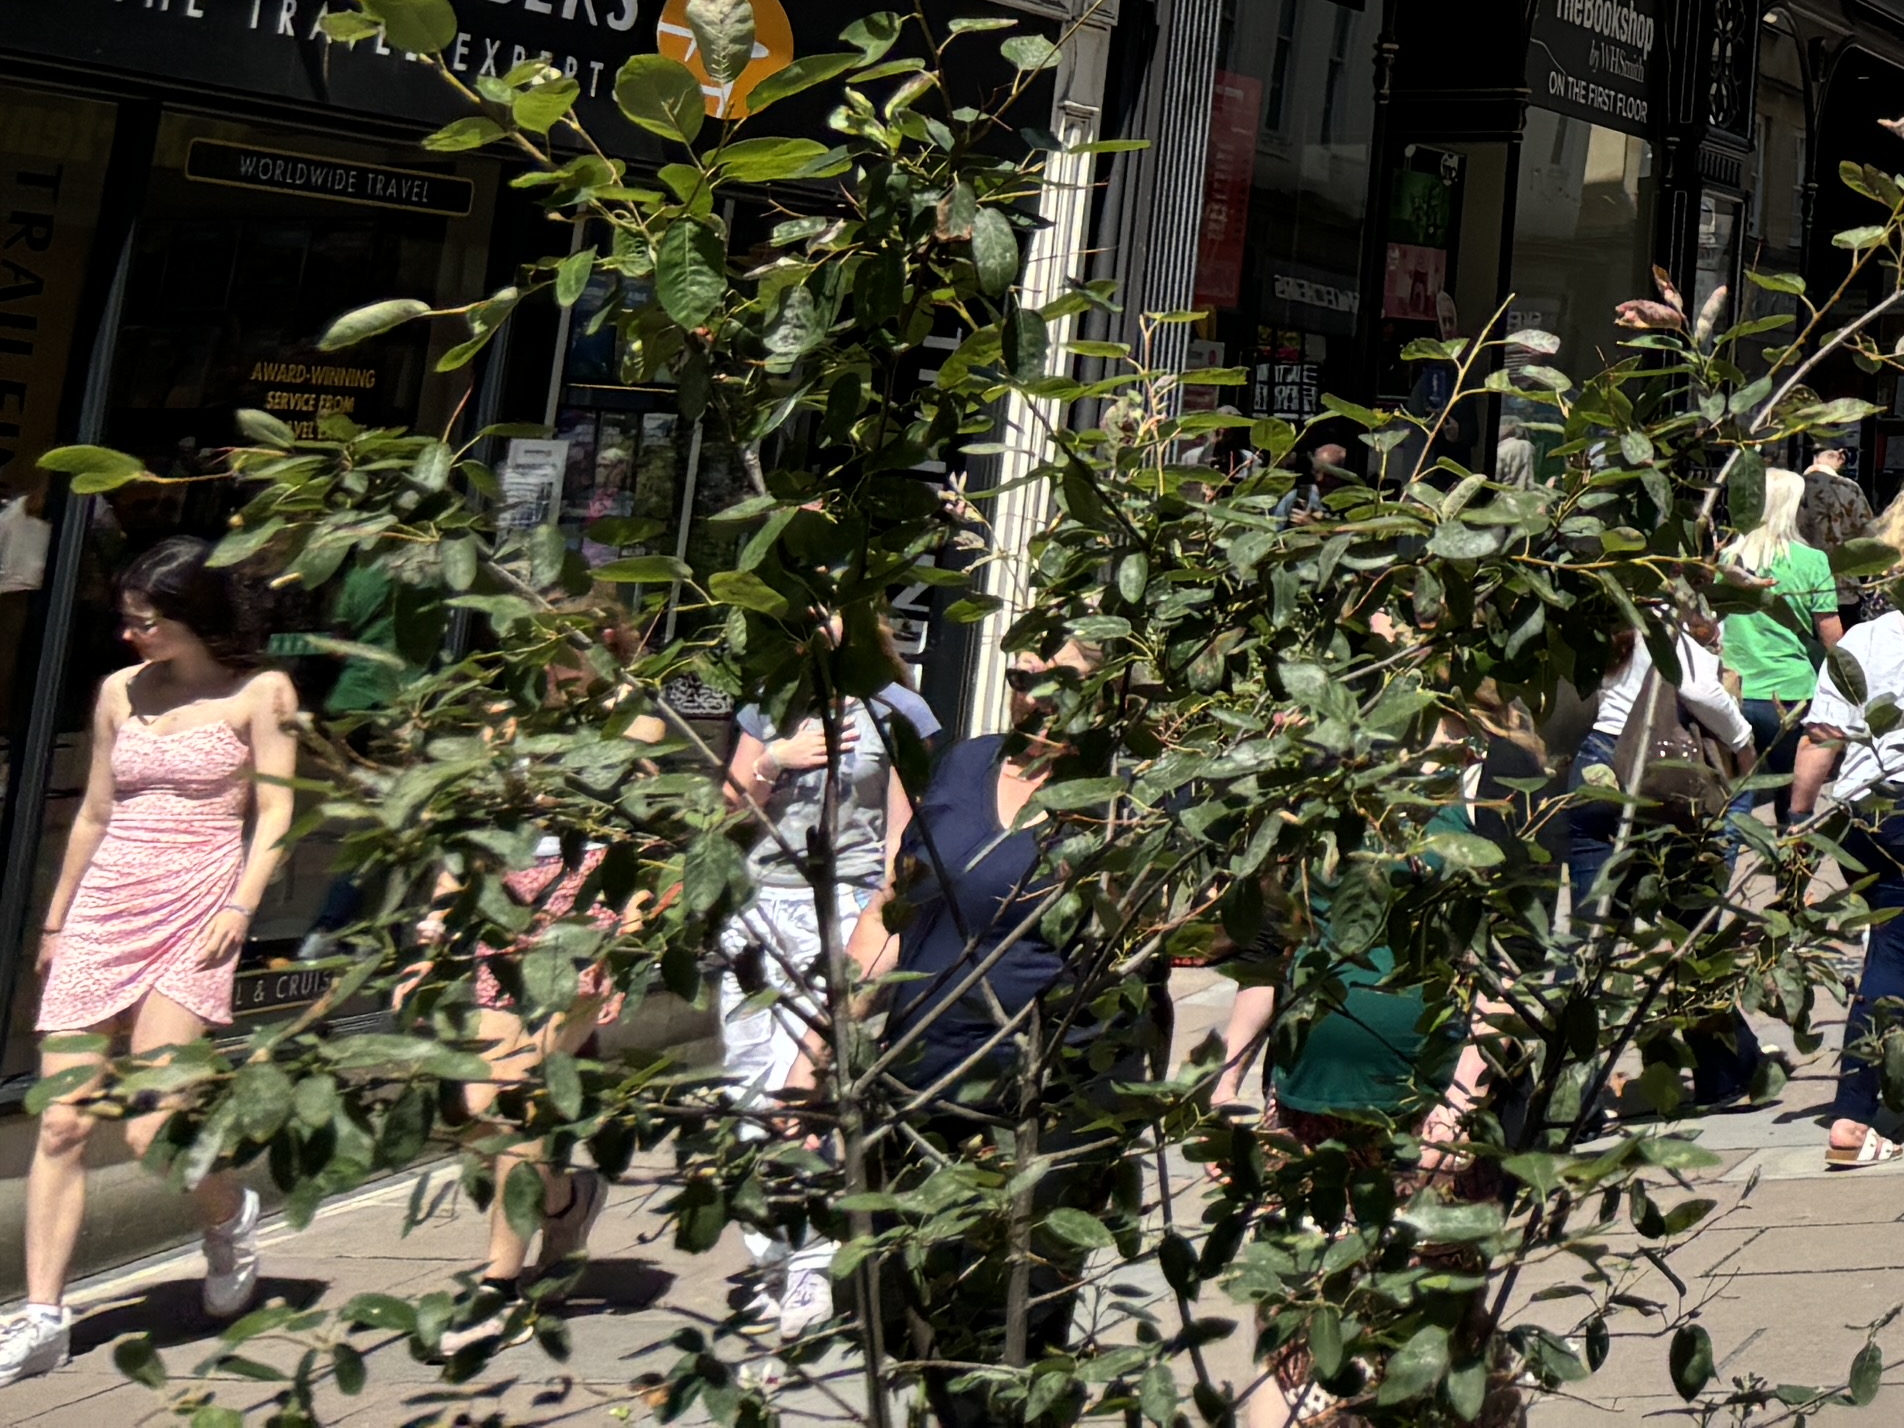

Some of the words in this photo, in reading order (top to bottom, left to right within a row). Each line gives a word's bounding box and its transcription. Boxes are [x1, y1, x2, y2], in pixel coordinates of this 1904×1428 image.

[1589, 39, 1600, 74] by
[1601, 41, 1646, 84] WHSmith
[1548, 70, 1566, 97] ON
[1566, 75, 1587, 105] THE
[1587, 82, 1615, 113] FIRST
[1615, 92, 1648, 125] FLOOR
[239, 154, 359, 193] WORLDWIDE
[366, 172, 430, 203] TRAVEL
[250, 361, 377, 389] AWARD-WINNING
[265, 390, 316, 413] SERVICE
[317, 393, 356, 414] FROM
